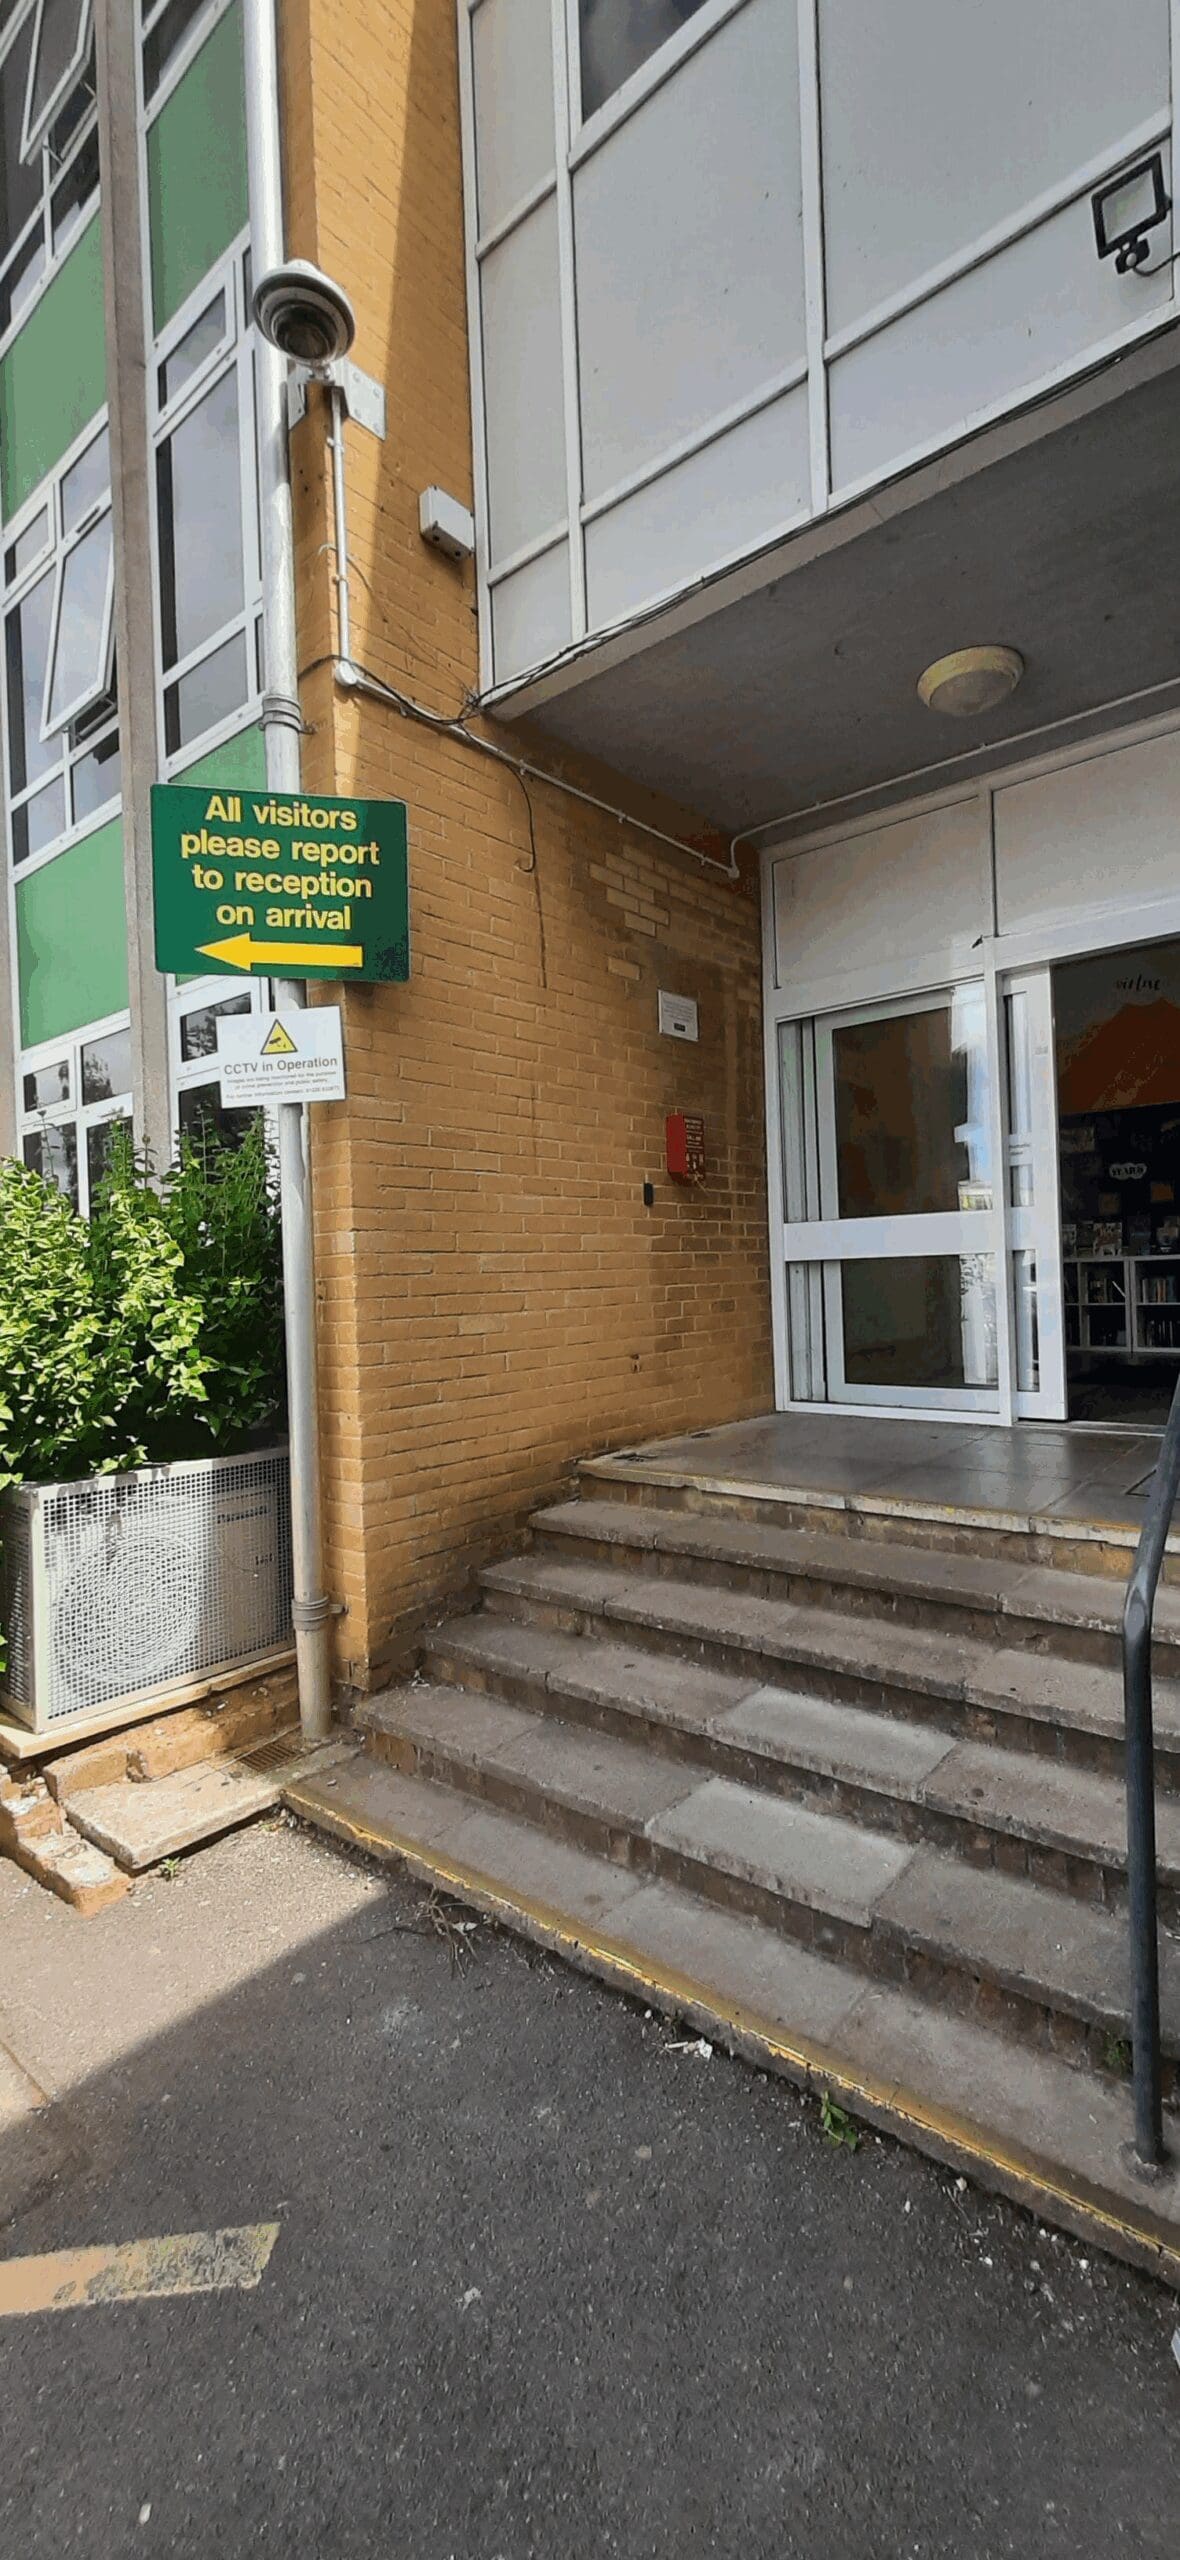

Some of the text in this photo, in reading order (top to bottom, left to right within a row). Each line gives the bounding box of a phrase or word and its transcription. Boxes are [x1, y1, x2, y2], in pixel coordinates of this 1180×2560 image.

[205, 795, 358, 831] All visitors
[181, 828, 380, 868] please report
[192, 864, 372, 900] to reception
[216, 903, 351, 930] on arrival
[224, 1057, 338, 1075] CCTV in Operation
